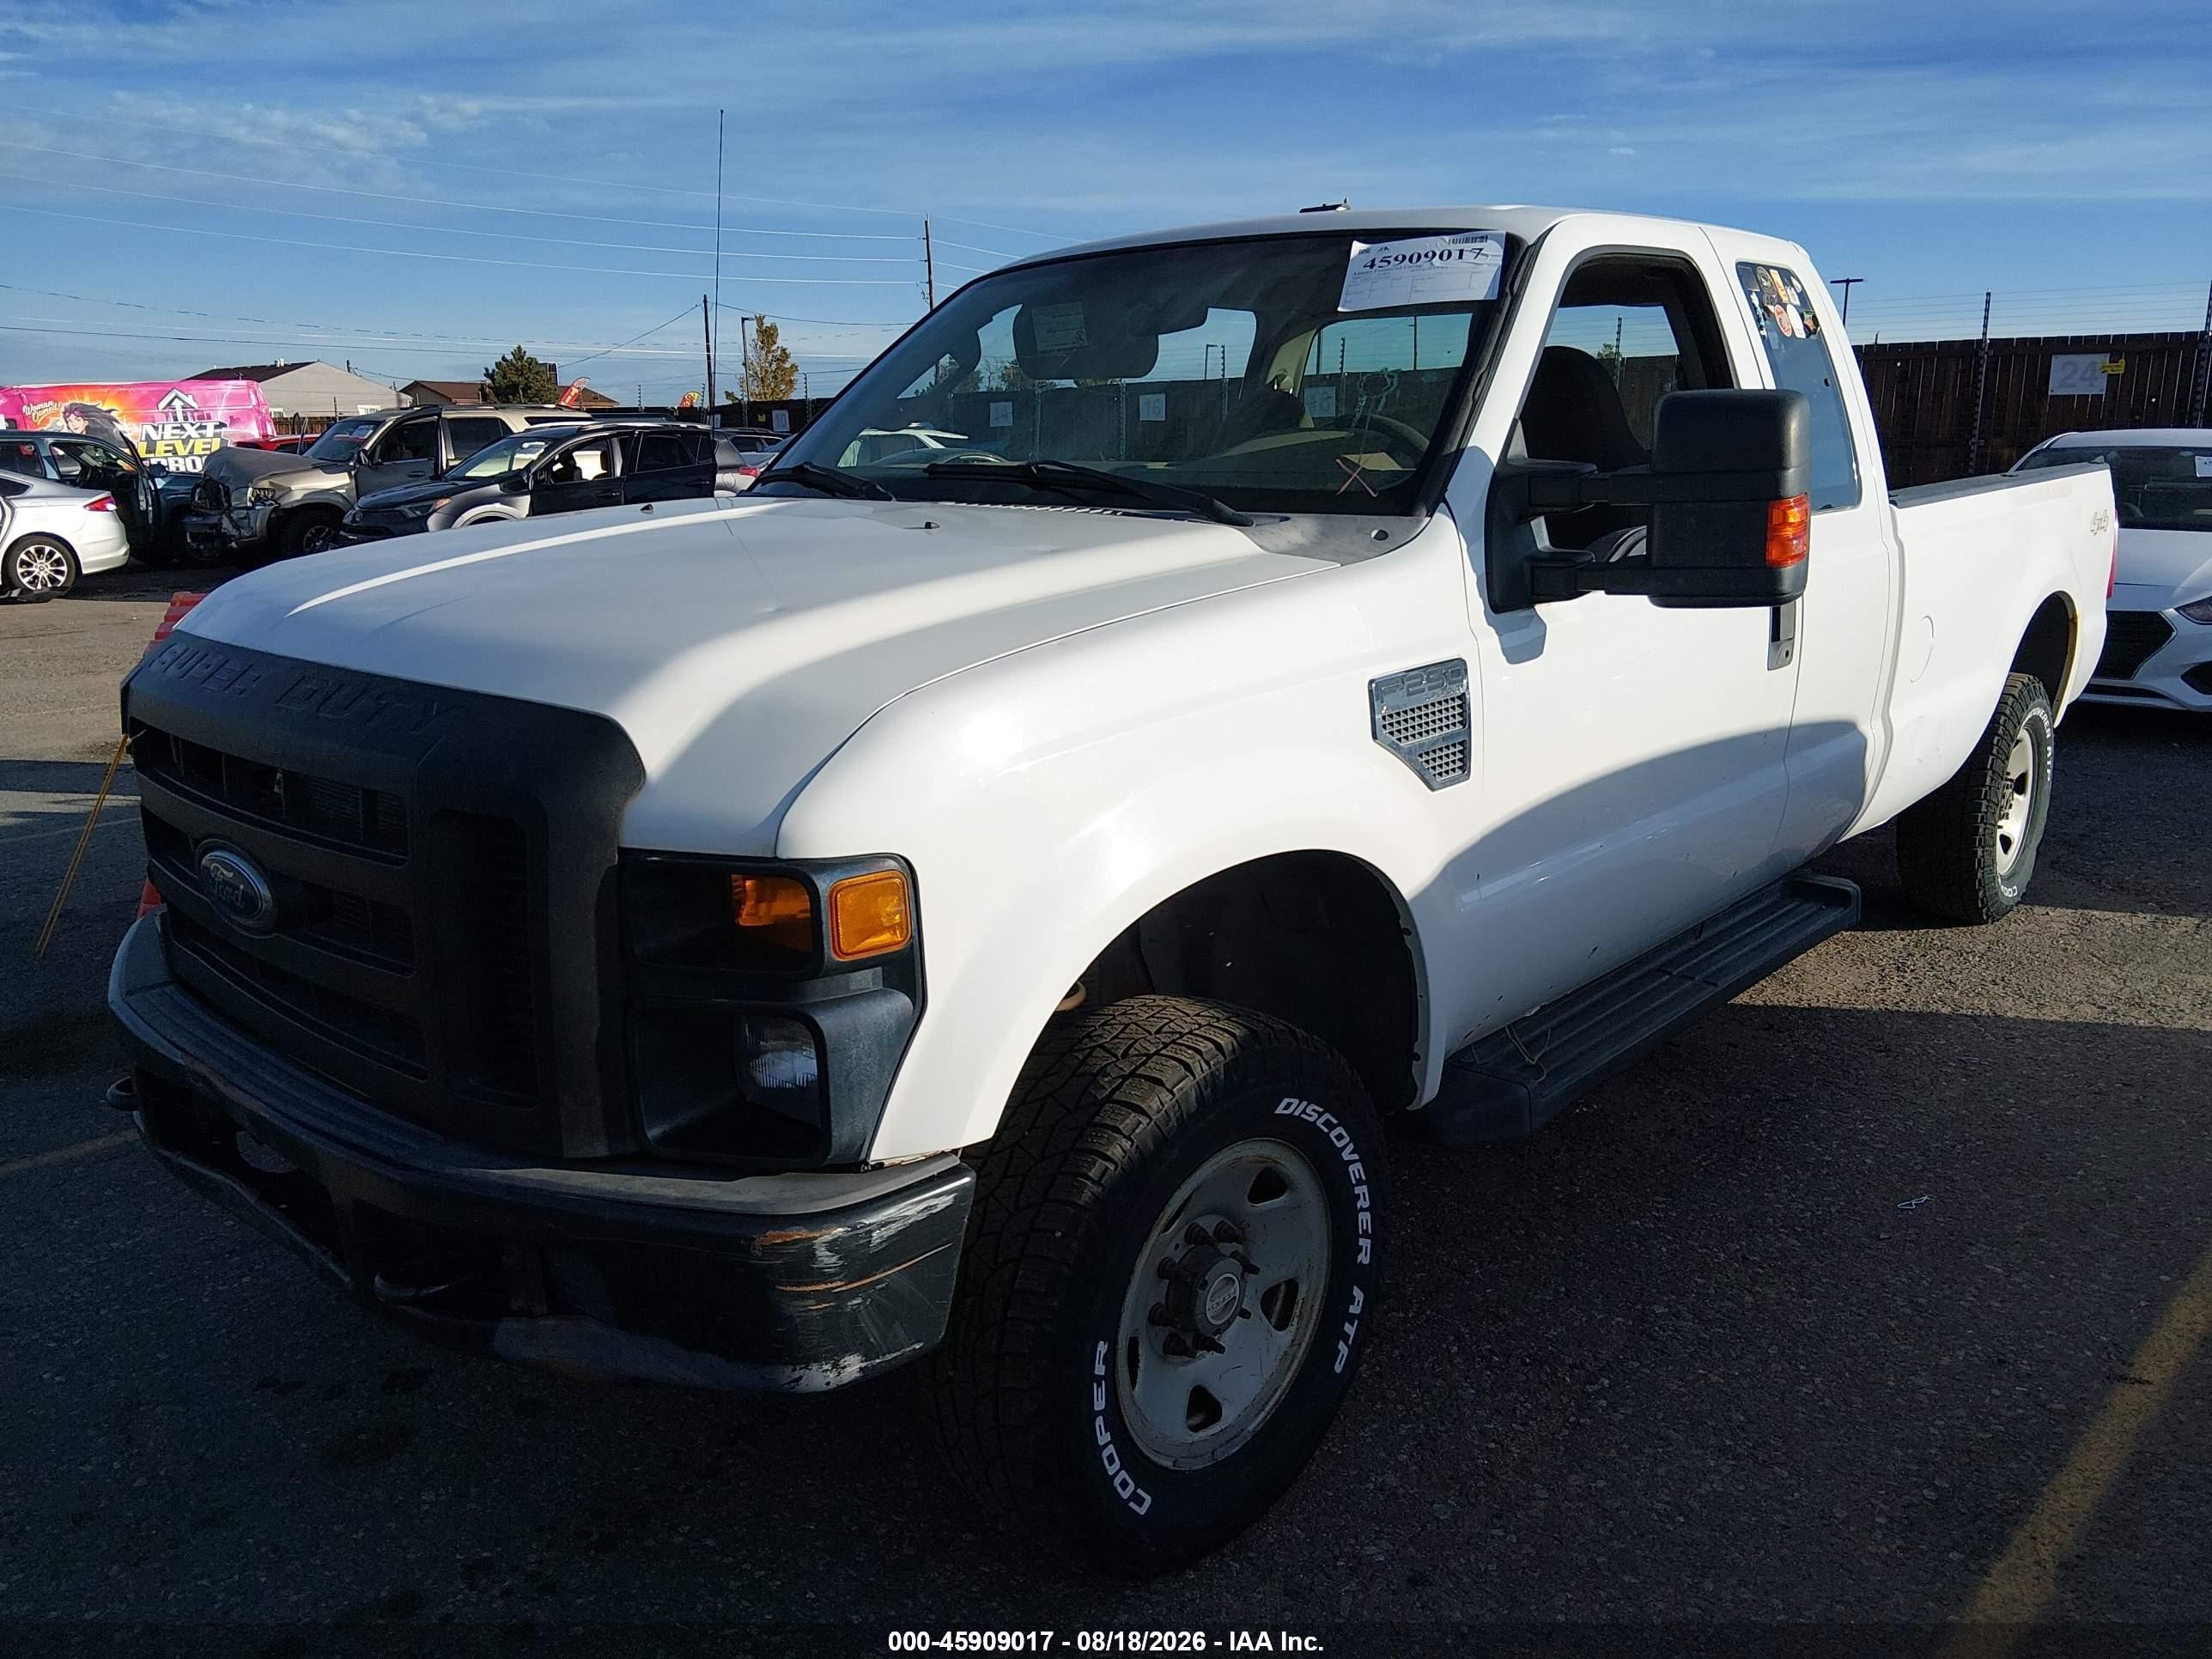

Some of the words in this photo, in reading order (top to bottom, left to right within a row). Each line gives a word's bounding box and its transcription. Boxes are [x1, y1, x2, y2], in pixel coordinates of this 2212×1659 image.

[1362, 247, 1485, 270] 45909017
[2059, 360, 2100, 388] 24
[22, 400, 54, 416] Woman
[142, 422, 220, 441] NEXT
[145, 641, 262, 696] SUPER
[275, 674, 464, 736] DUTY
[209, 862, 246, 908] Ford
[1274, 1097, 1373, 1265] DISCOVERER
[1333, 1285, 1364, 1376] ATP
[1091, 1339, 1152, 1516] COOPER
